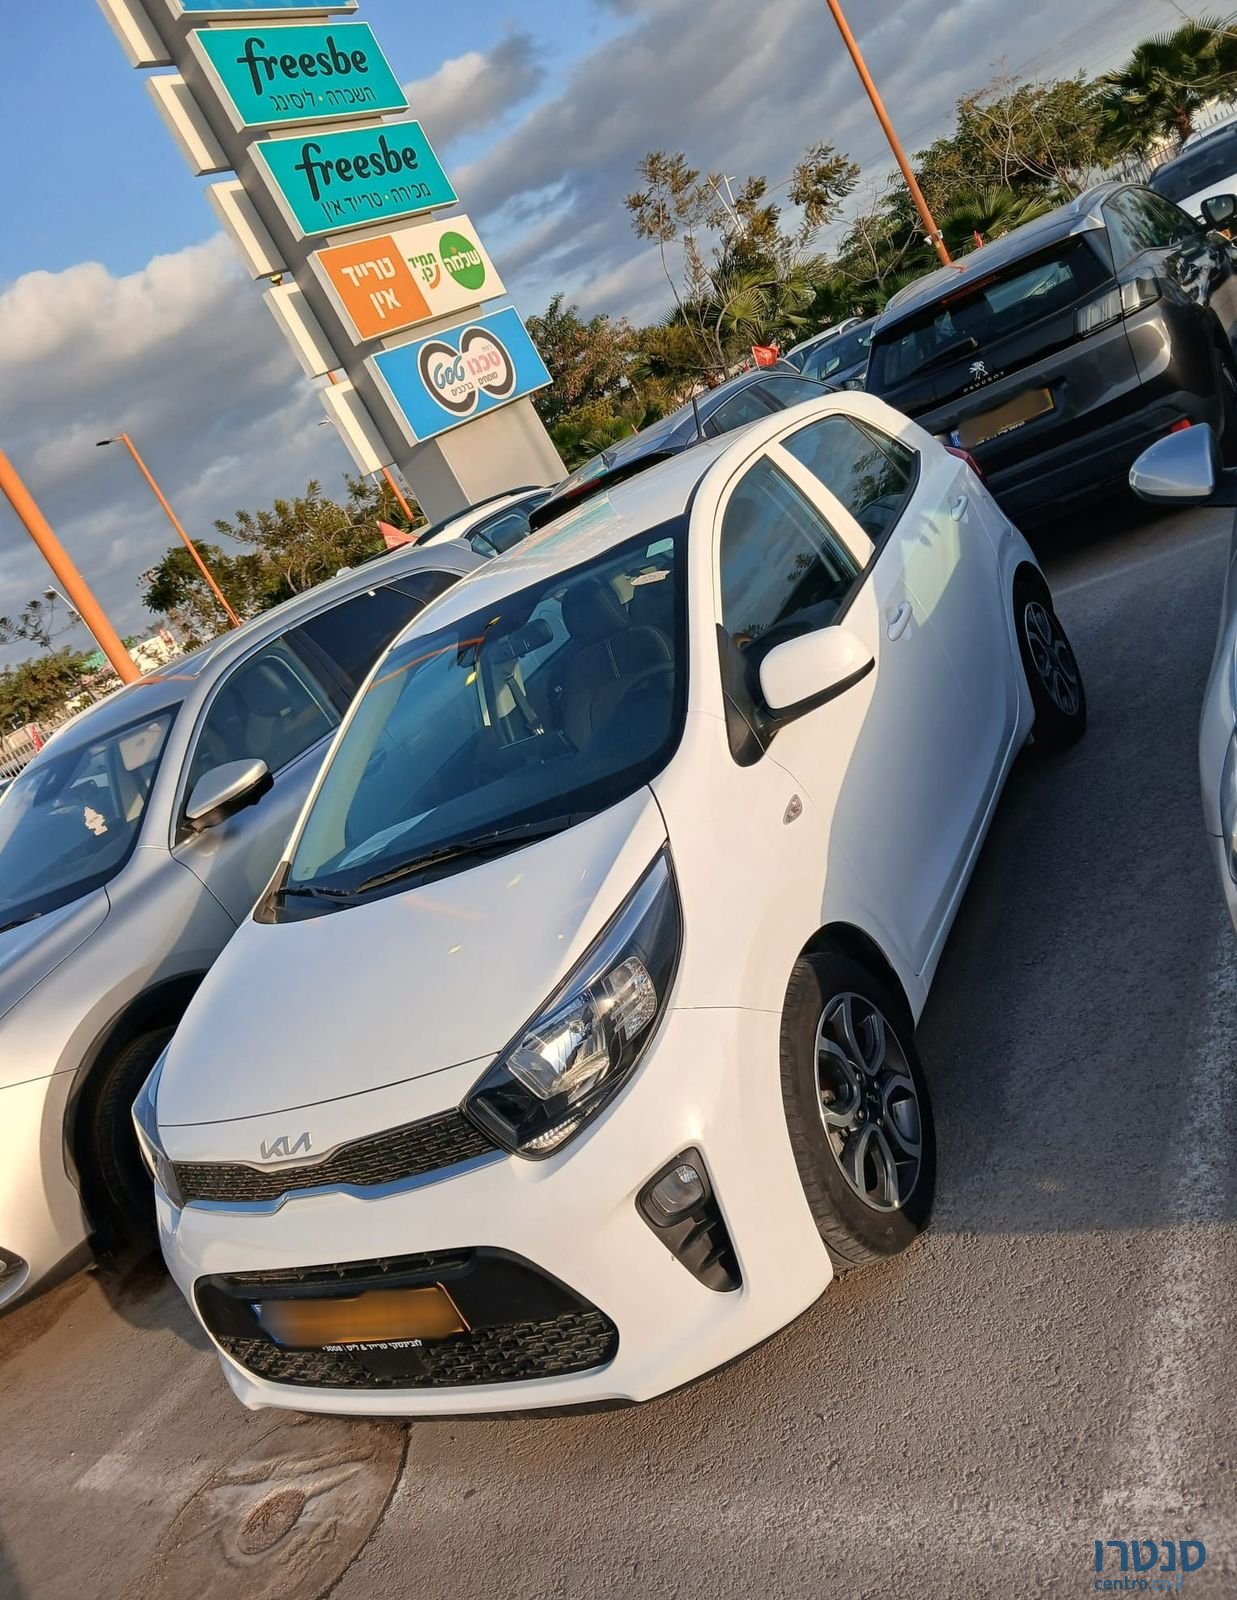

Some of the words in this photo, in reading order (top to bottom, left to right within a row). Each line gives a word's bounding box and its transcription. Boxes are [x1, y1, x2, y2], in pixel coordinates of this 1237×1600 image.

[236, 35, 369, 96] freesbe
[269, 88, 315, 112] ליסינג
[325, 87, 376, 106] השכרה
[294, 134, 419, 202] freesbe
[344, 192, 383, 211] טרייד
[390, 182, 431, 203] מכירה
[320, 198, 346, 223] אין
[341, 256, 396, 287] טרייד
[407, 252, 437, 268] תמיד
[443, 249, 481, 274] שלמה
[369, 288, 402, 319] אין
[466, 350, 501, 376] טכנו
[963, 370, 1005, 393] PEUGEOT
[260, 1131, 312, 1160] KIA
